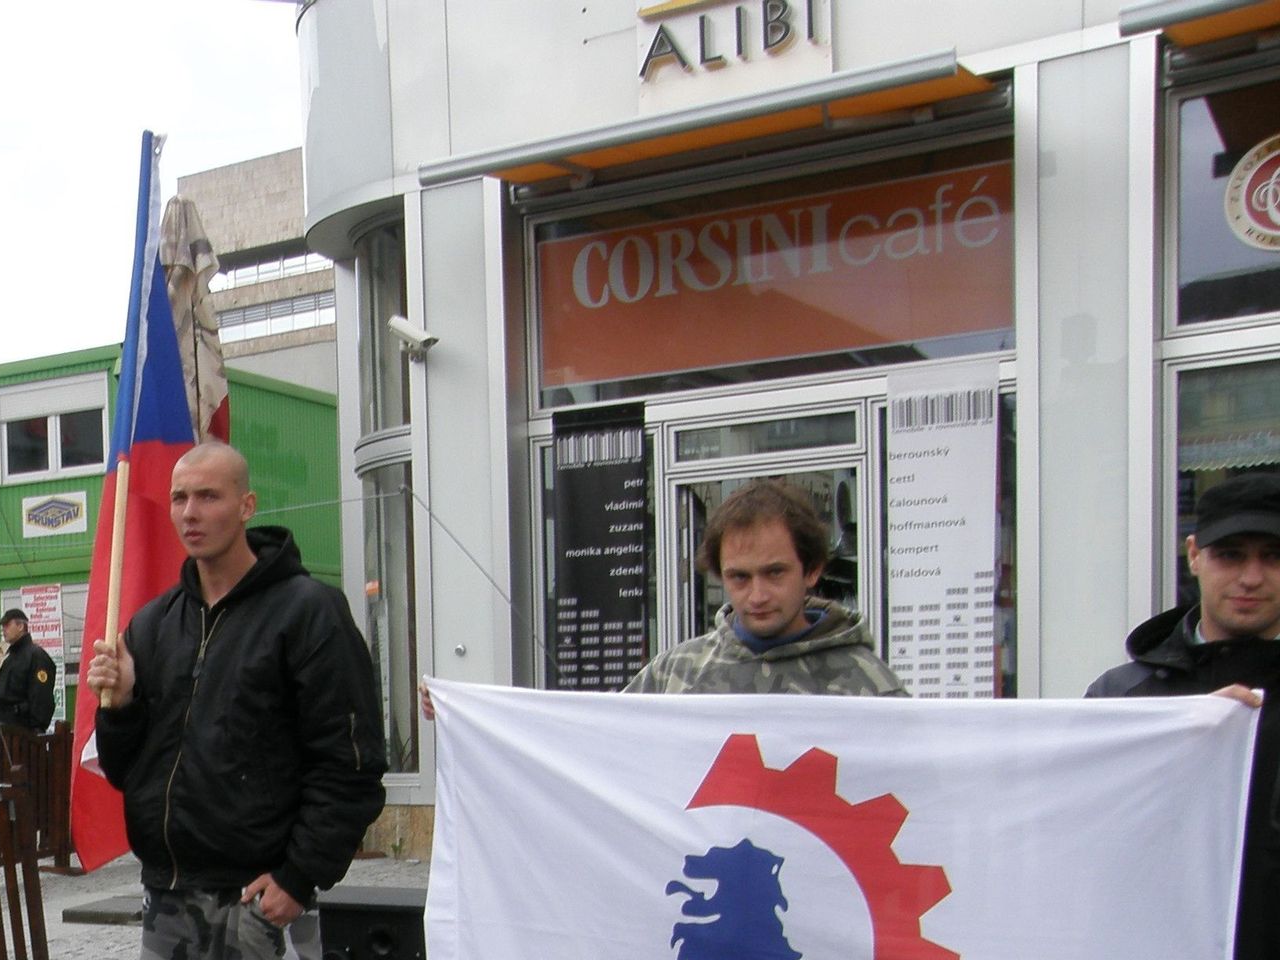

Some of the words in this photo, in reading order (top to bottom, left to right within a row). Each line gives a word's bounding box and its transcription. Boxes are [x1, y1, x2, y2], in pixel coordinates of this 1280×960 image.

[639, 0, 816, 80] ALIBI
[572, 202, 833, 309] CORSINI
[837, 175, 1000, 268] café
[888, 446, 950, 461] berounský
[624, 478, 644, 490] petr
[889, 473, 915, 484] cettl
[889, 516, 966, 531] hoffmannová
[565, 546, 601, 558] monika
[890, 544, 939, 555] kompert
